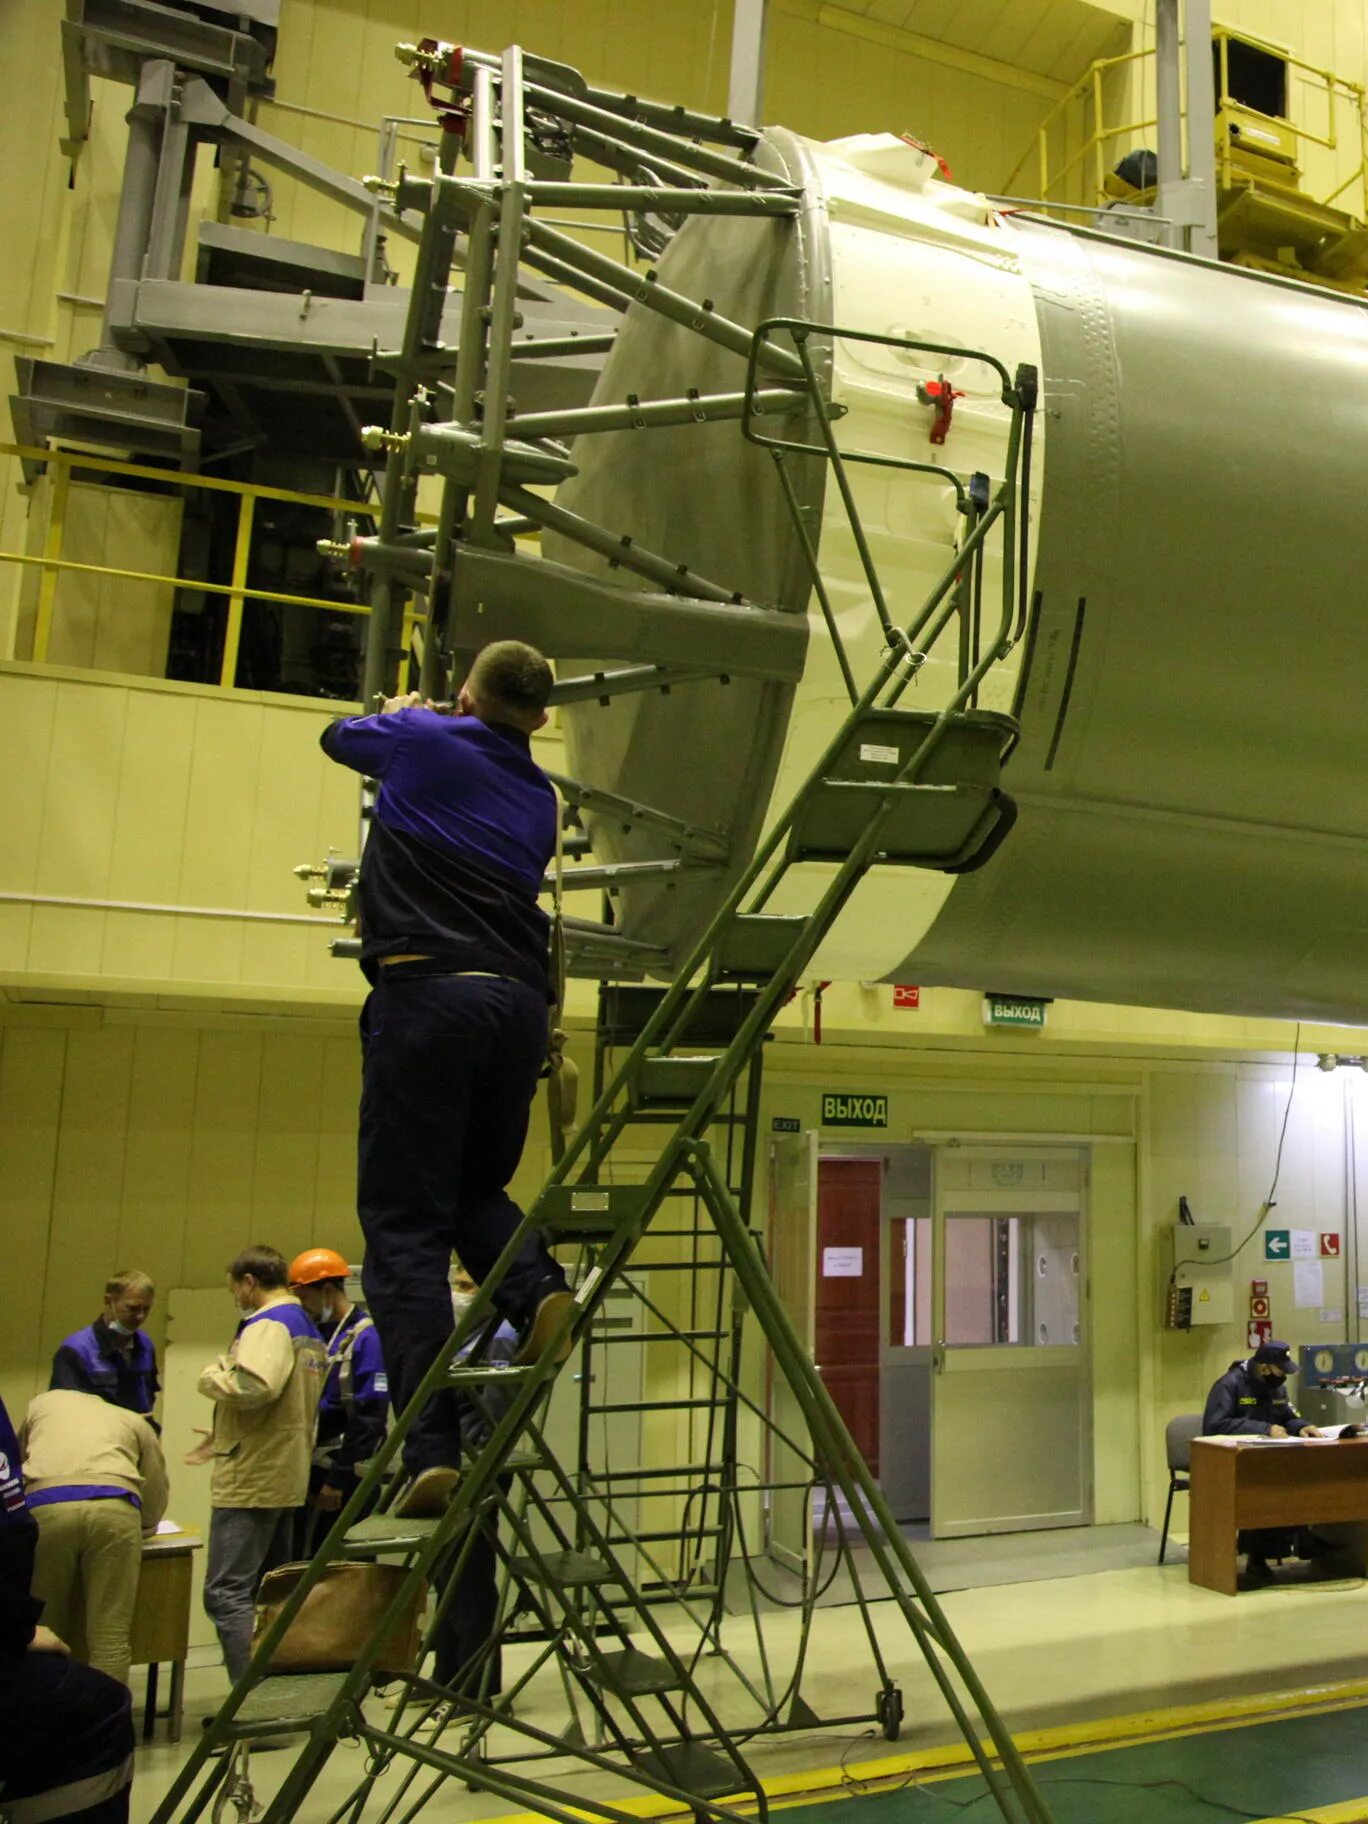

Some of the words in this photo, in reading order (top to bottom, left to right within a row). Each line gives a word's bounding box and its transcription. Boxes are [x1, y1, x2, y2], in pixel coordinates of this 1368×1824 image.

[993, 1005, 1041, 1021] ВЫХОД
[824, 1098, 887, 1125] ВЫХОД
[774, 1119, 799, 1131] EXIT
